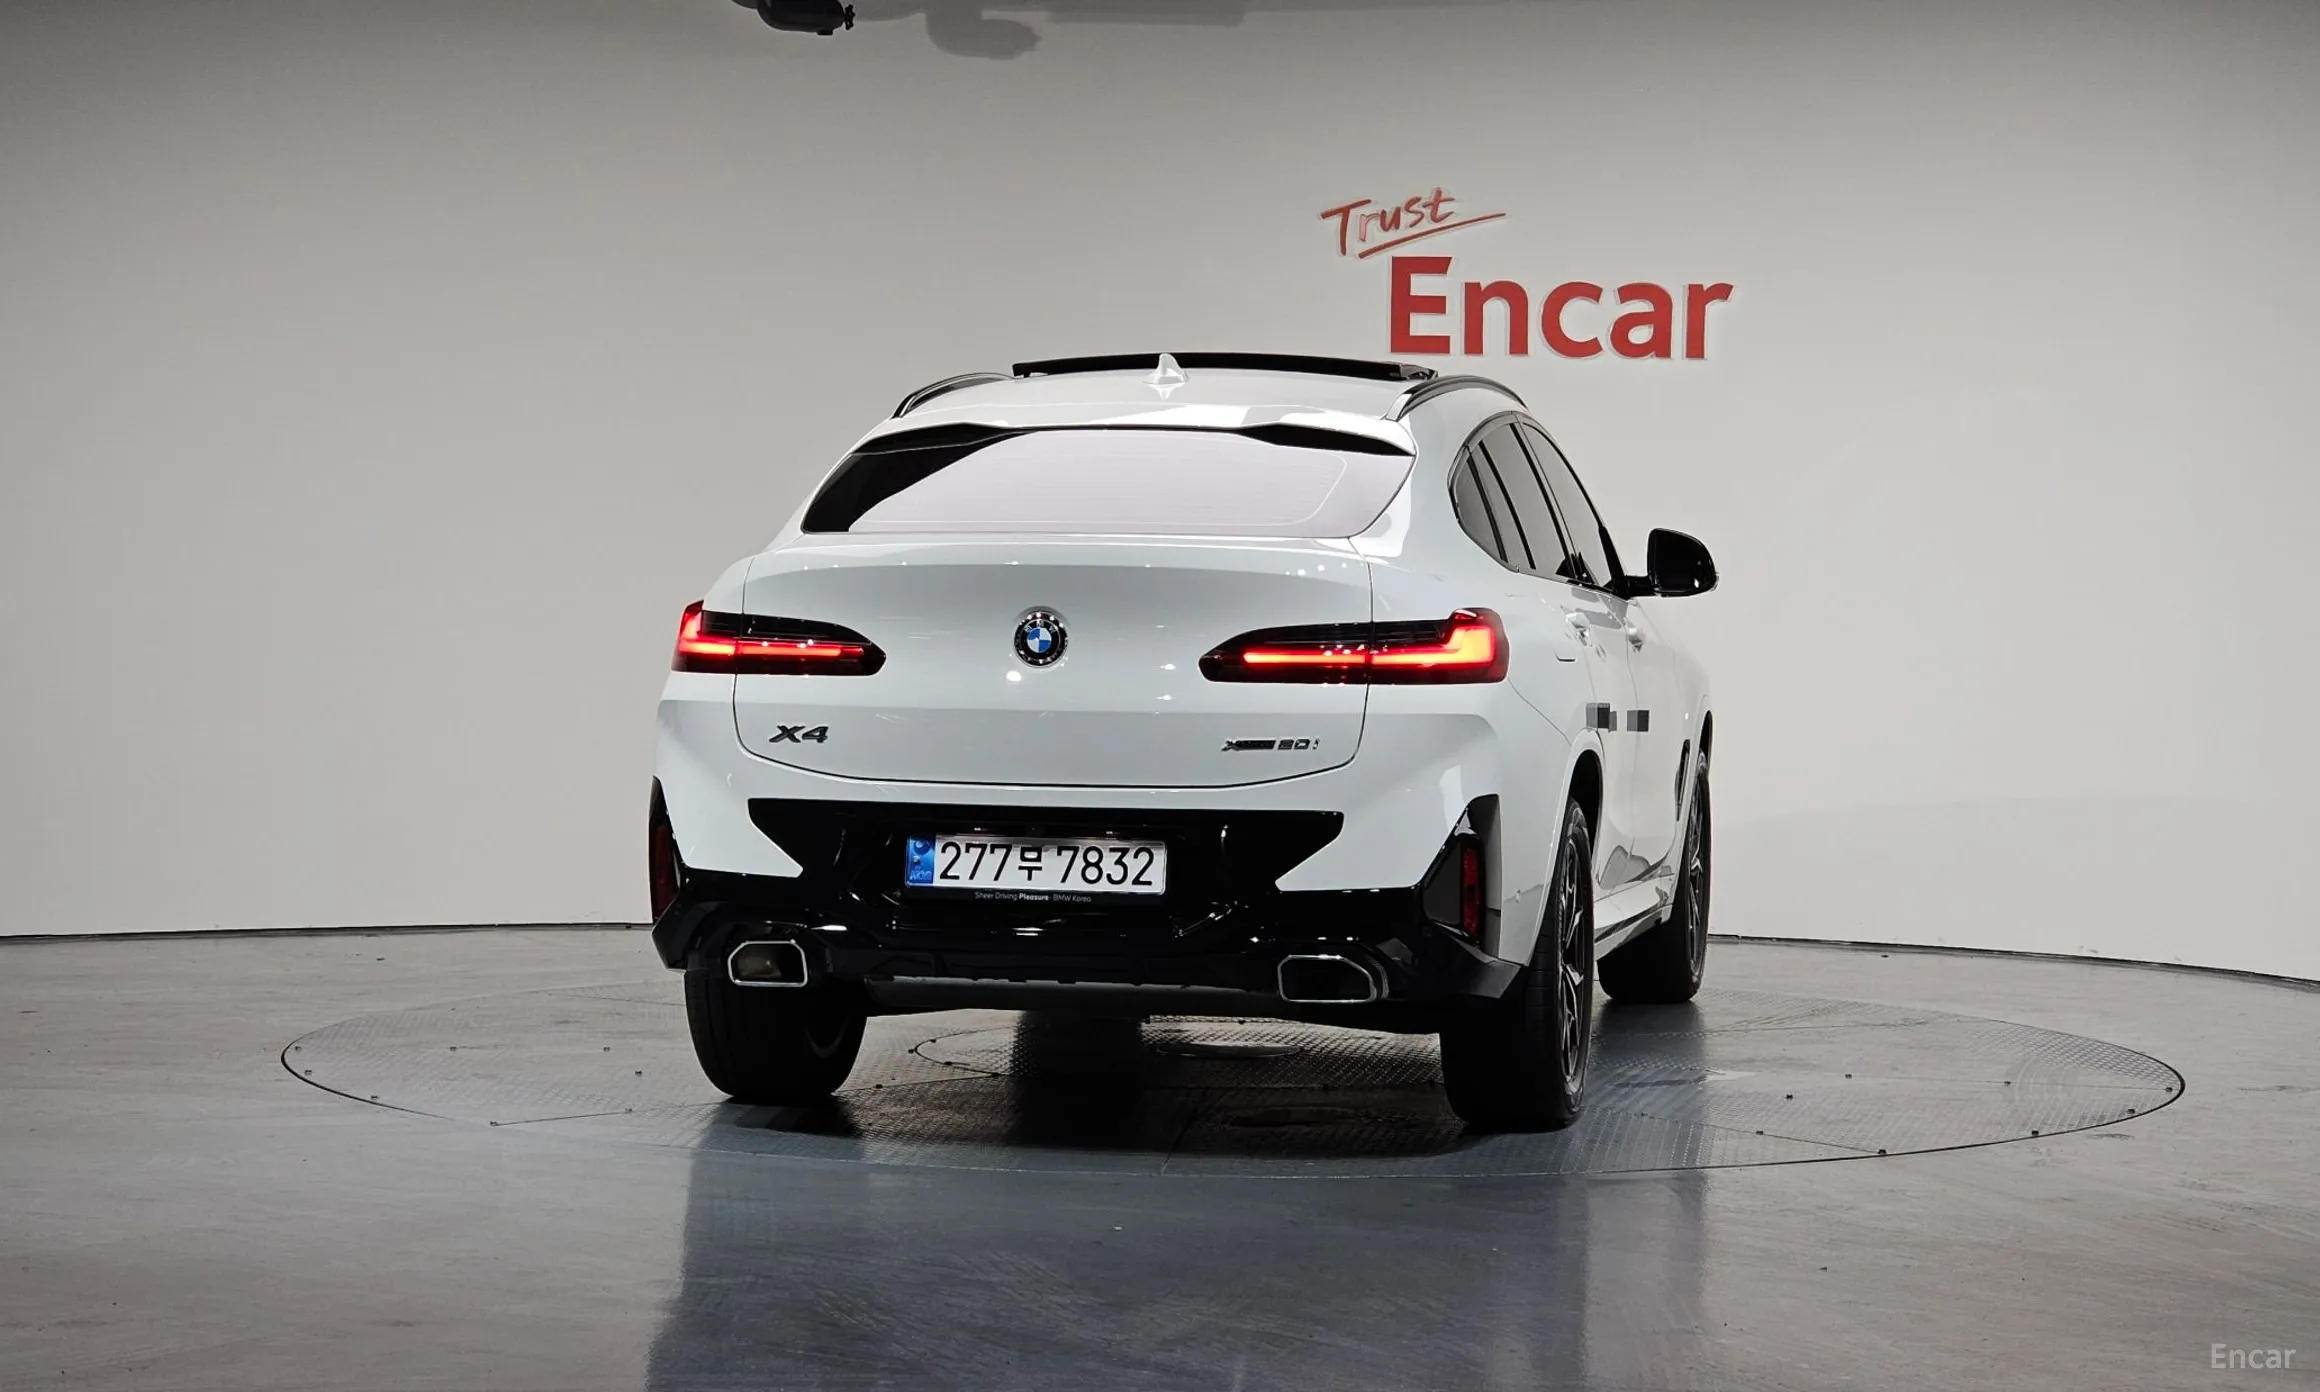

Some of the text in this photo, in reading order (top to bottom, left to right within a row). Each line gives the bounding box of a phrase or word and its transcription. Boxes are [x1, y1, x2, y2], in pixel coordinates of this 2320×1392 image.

[1319, 187, 1457, 256] Trust
[1390, 256, 1735, 360] Encar
[769, 725, 829, 743] X4
[939, 841, 1155, 886] 277무 7832
[995, 892, 1018, 901] Driving
[1018, 892, 1050, 901] Pleasure
[1053, 893, 1072, 901] BMW
[1072, 894, 1092, 903] Korea
